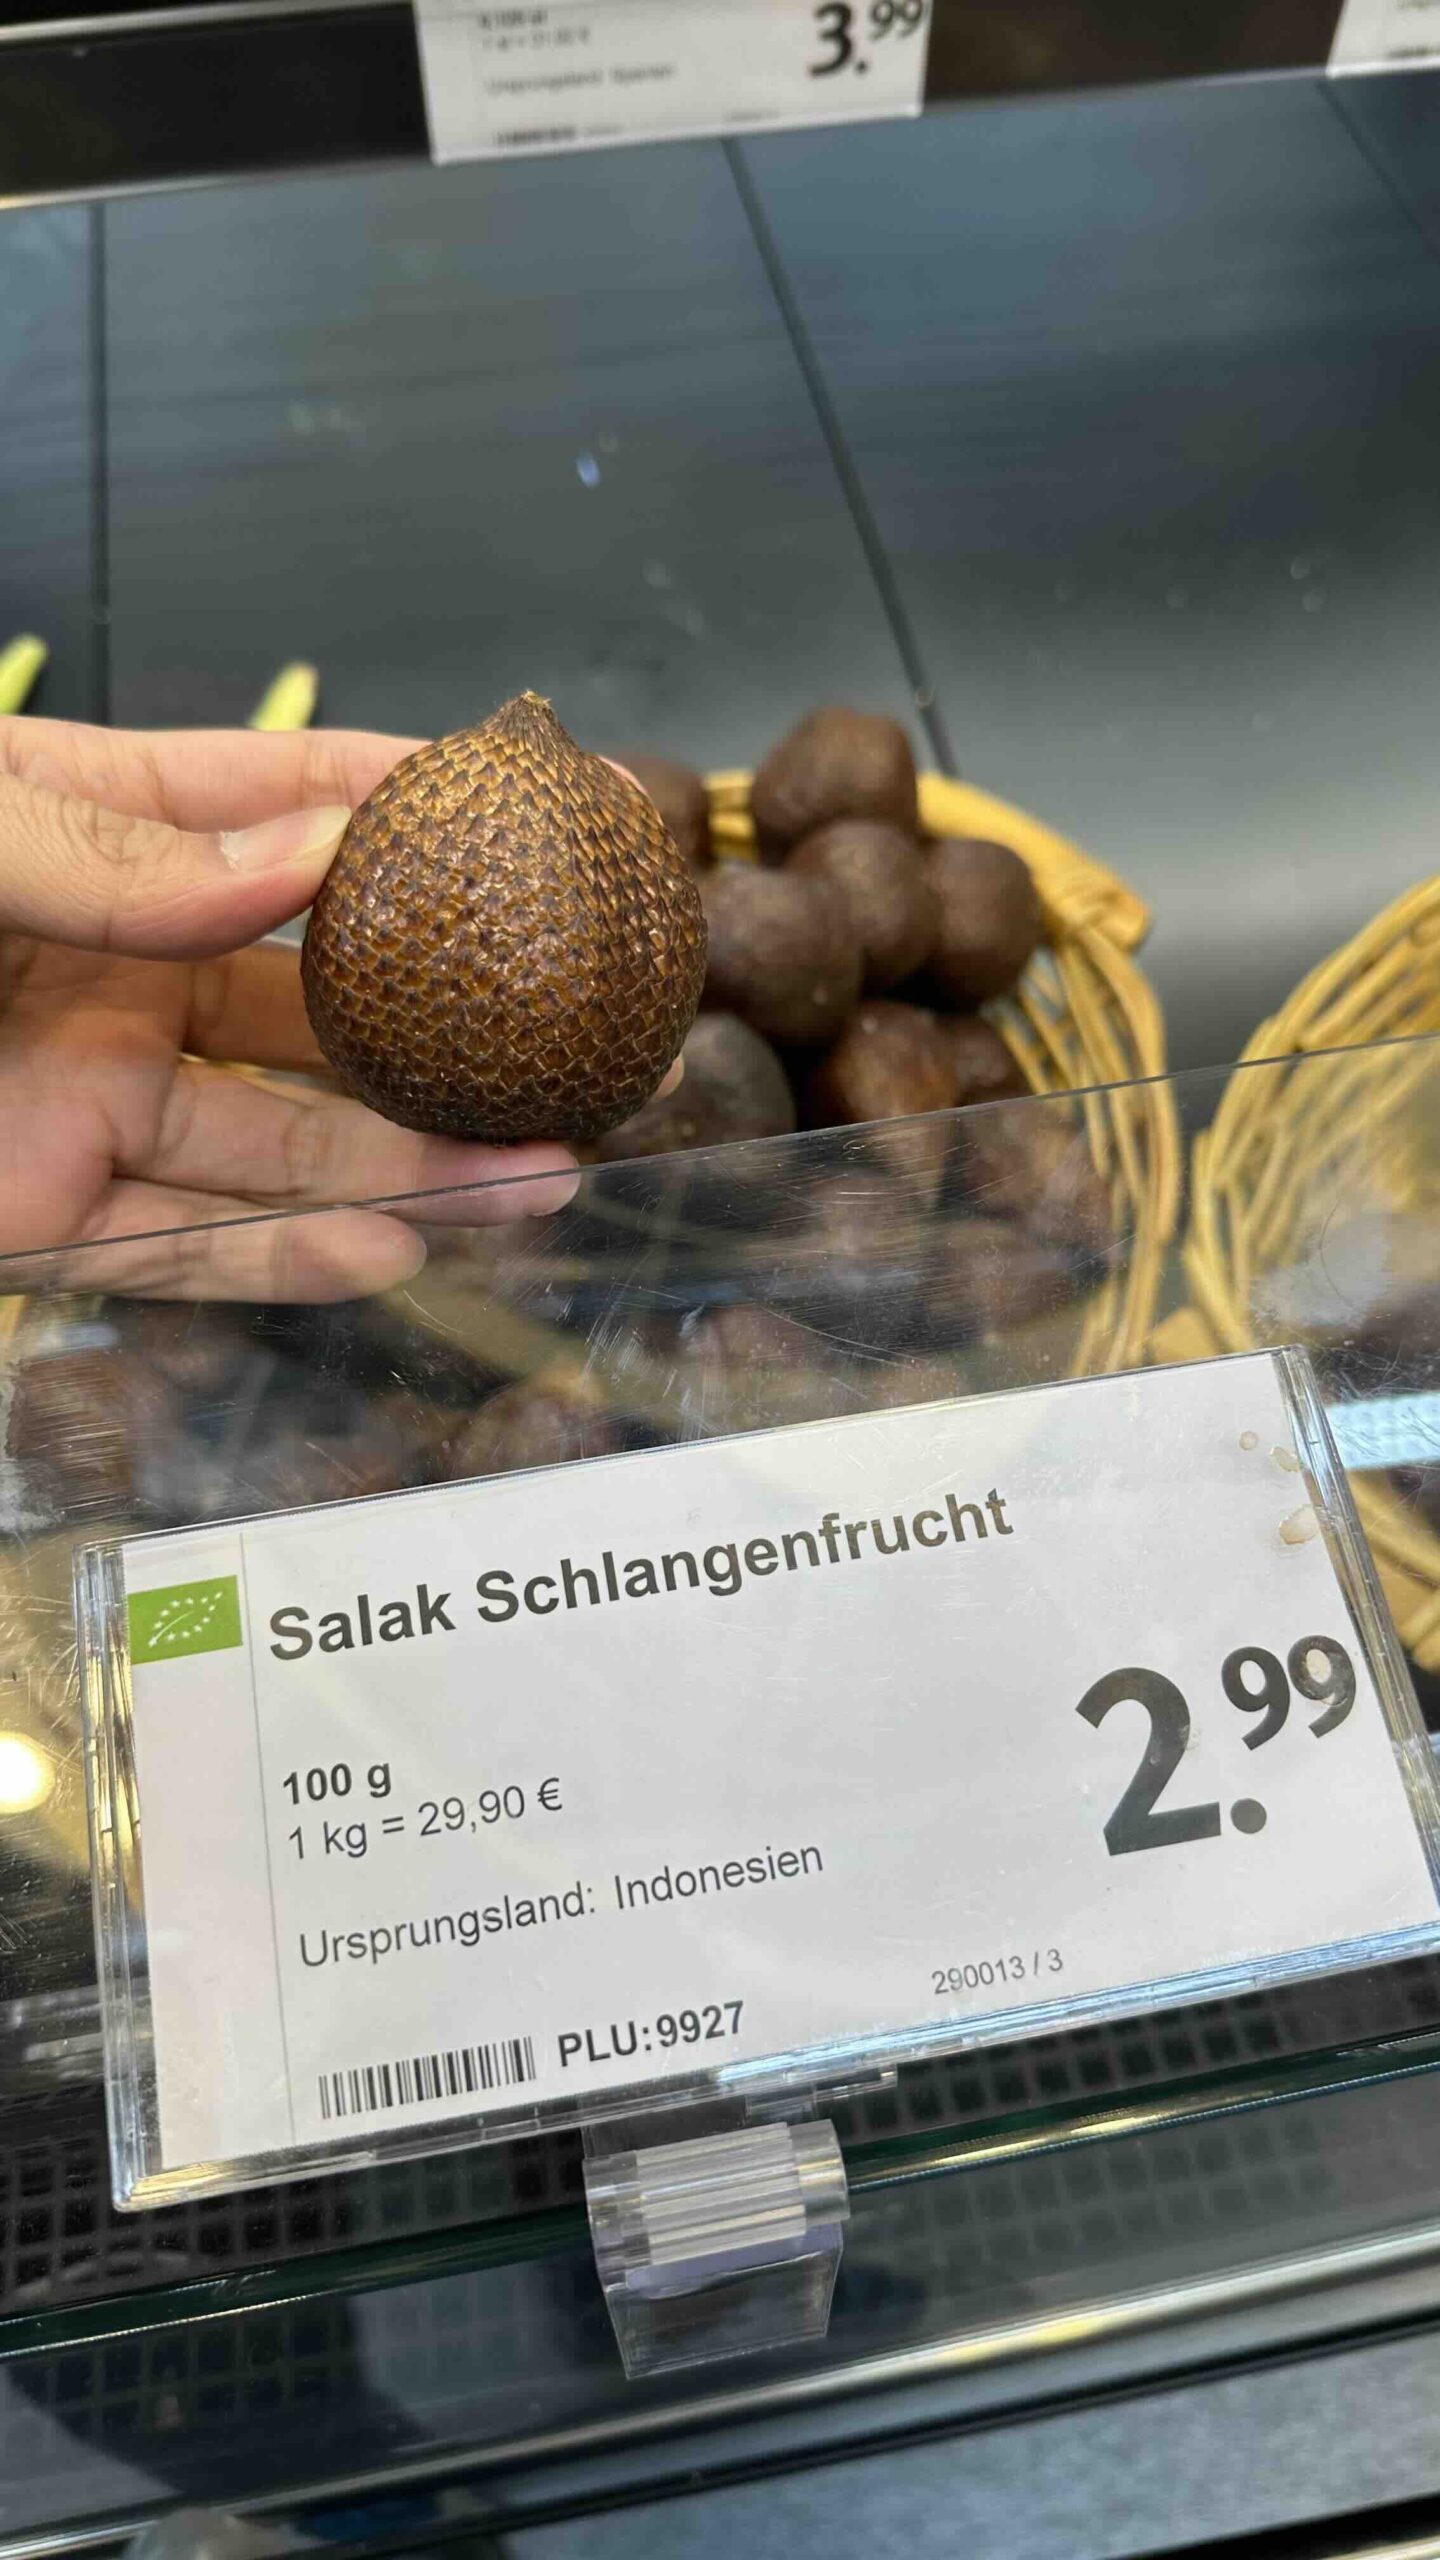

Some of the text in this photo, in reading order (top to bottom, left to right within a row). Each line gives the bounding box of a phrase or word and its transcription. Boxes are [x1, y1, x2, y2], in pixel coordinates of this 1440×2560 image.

[808, 0, 923, 77] 3.99
[269, 1488, 1014, 1661] Salak Schlangenfrucht
[283, 1763, 392, 1806] 100 g
[1074, 1634, 1358, 1857] 2.99
[289, 1777, 563, 1860] 1 kg = 29,90 €
[299, 1845, 823, 1967] Ursprungsland: Indonesien
[931, 1955, 1026, 1995] 290013
[1047, 1948, 1064, 1973] 3
[557, 2000, 745, 2067] PLU:9927
